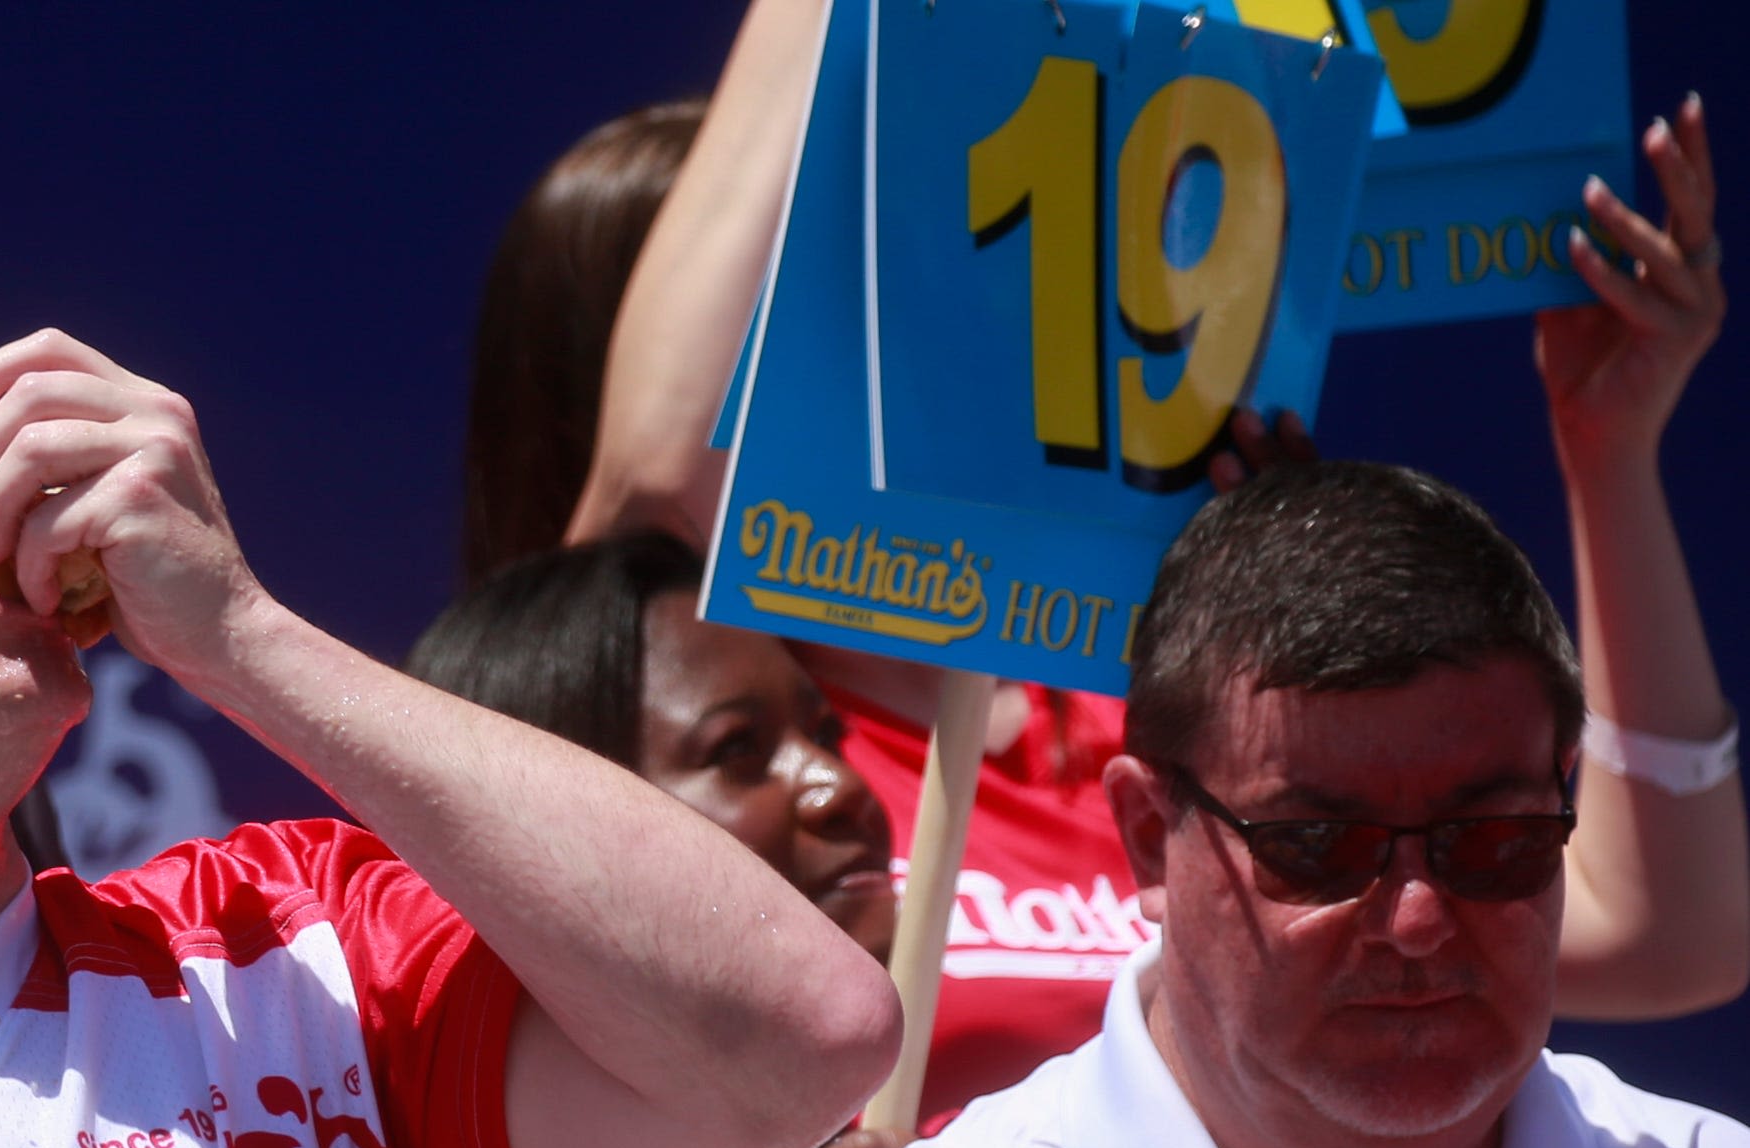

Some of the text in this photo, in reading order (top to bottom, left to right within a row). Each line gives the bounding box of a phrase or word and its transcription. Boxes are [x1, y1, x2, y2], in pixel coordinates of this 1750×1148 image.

[968, 54, 1288, 494] 19
[1343, 231, 1424, 296] OT
[739, 499, 986, 619] Nathan's
[999, 579, 1113, 660] HOT
[889, 858, 1163, 952] Nath
[178, 1084, 229, 1142] 196
